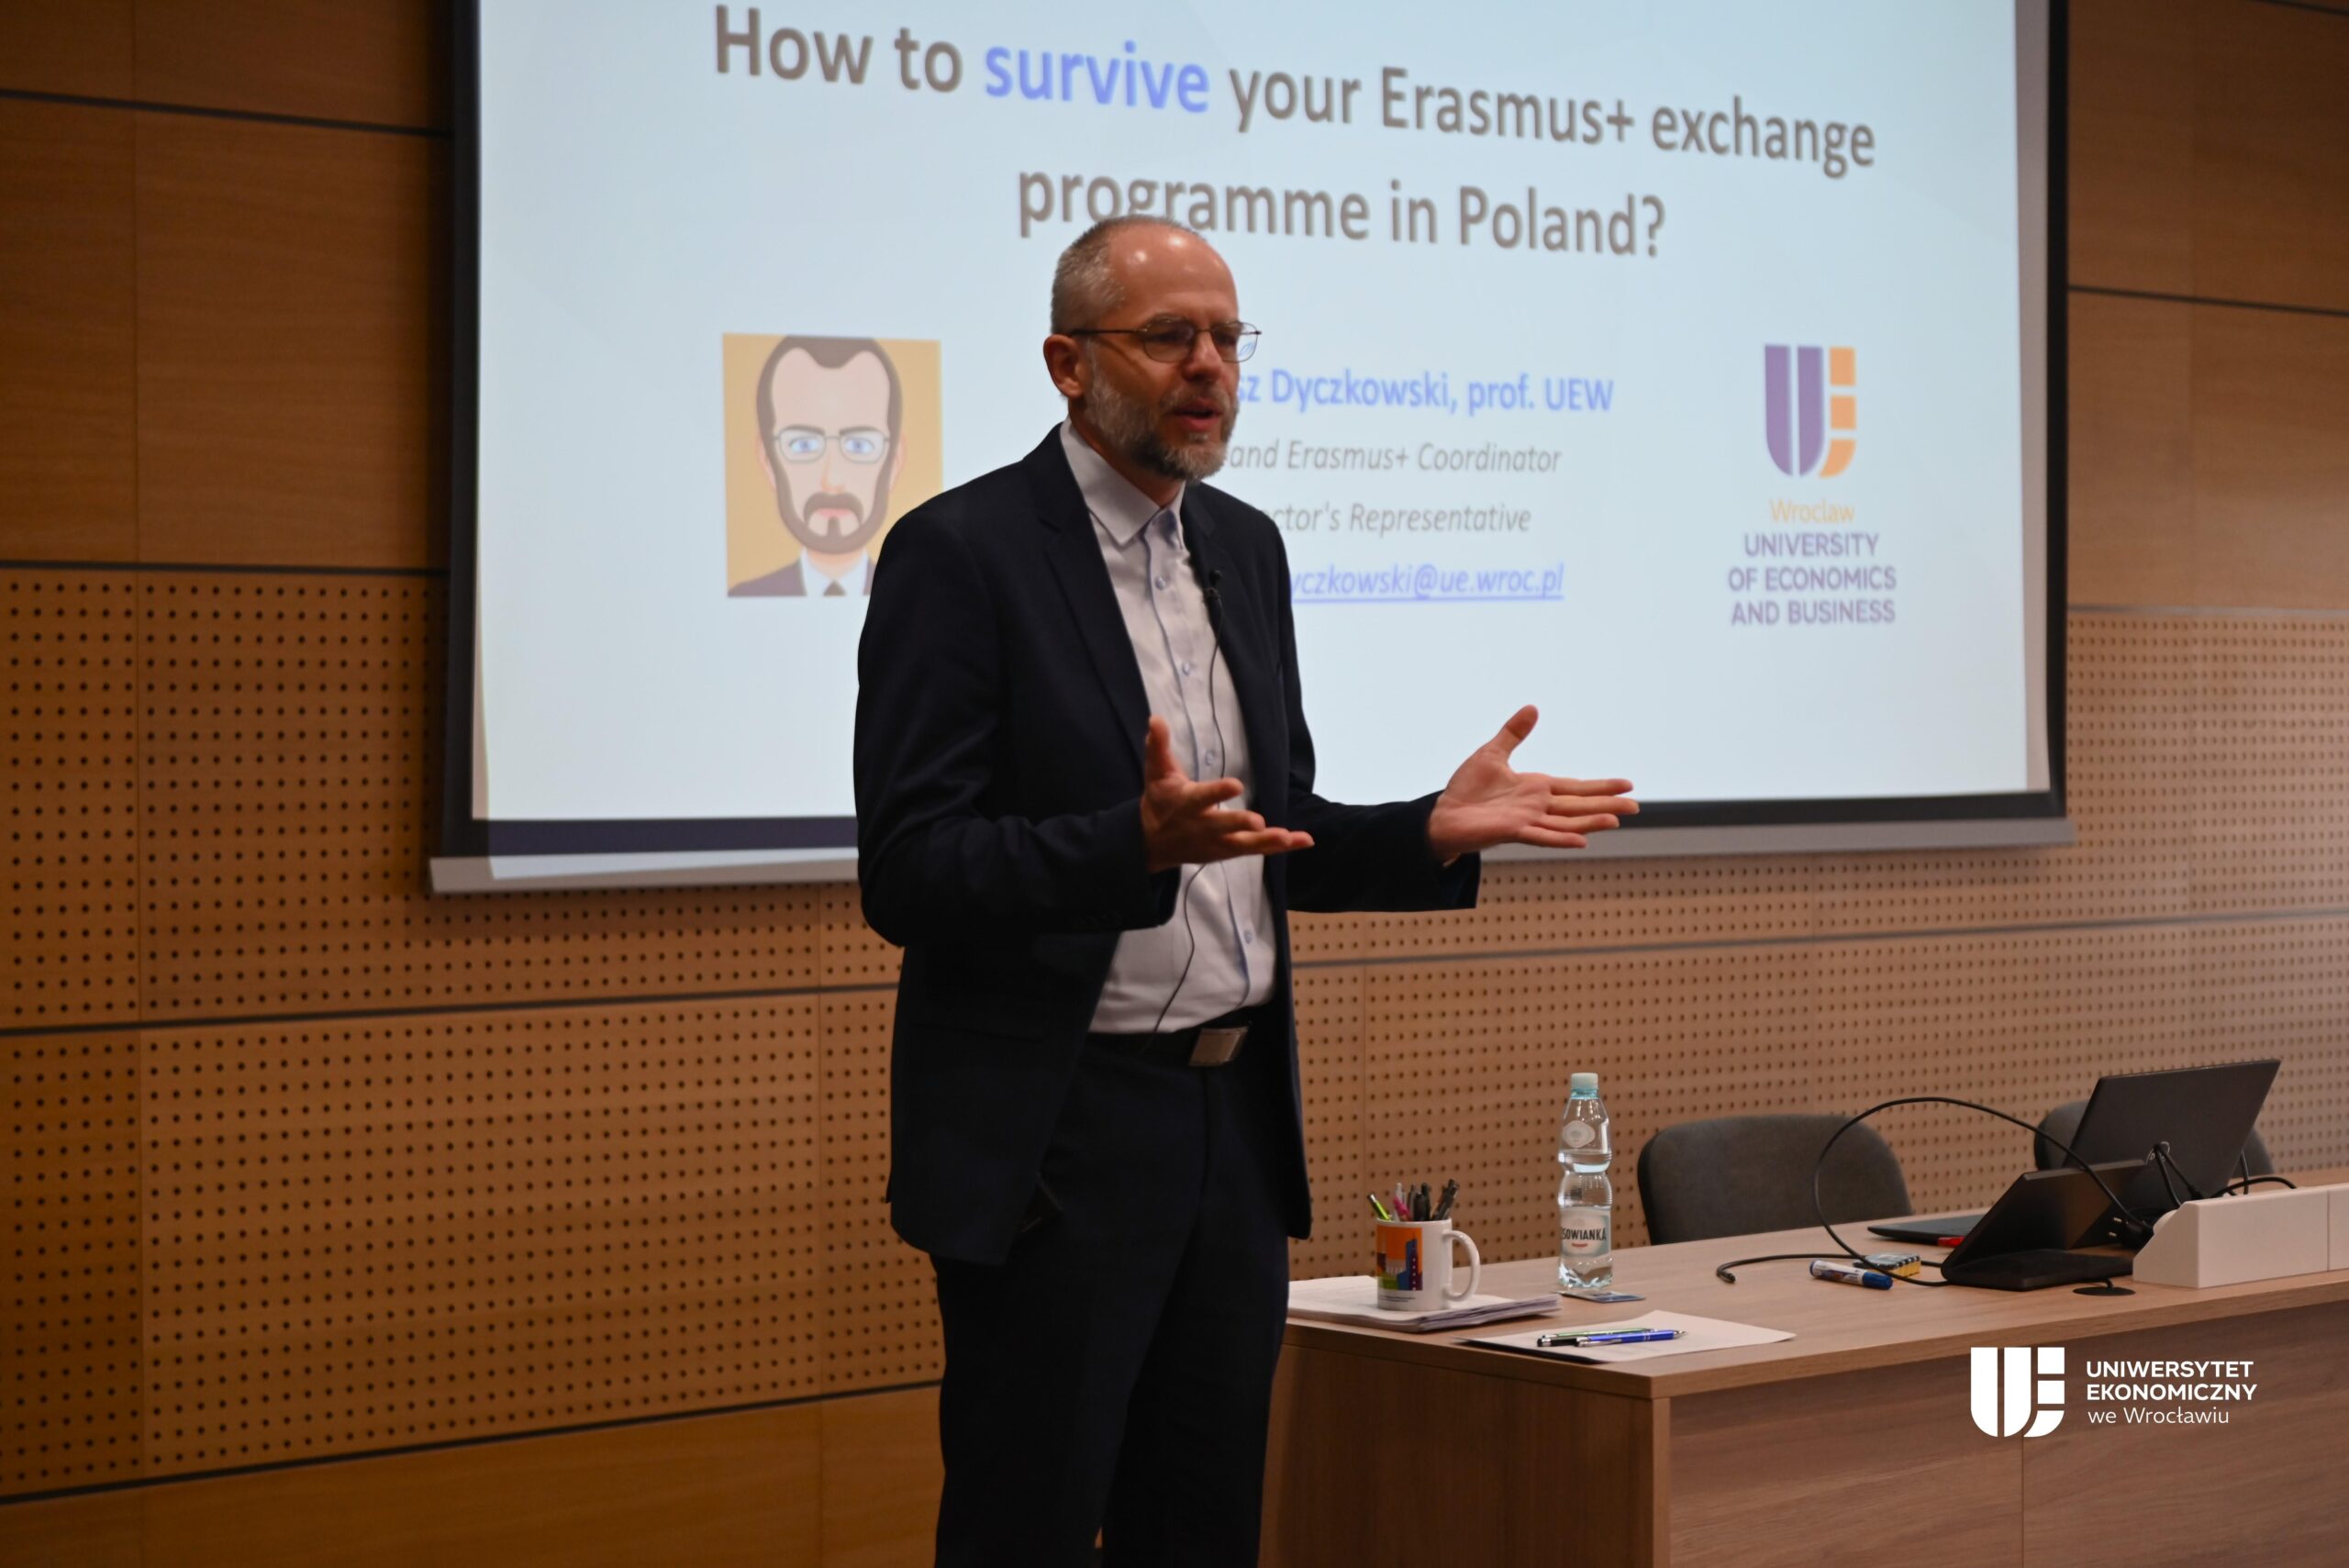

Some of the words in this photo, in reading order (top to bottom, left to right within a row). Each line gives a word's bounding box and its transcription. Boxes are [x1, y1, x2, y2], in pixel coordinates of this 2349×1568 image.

[716, 5, 874, 84] How
[894, 28, 963, 93] to
[985, 40, 1209, 113] survive
[1230, 68, 1361, 133] your
[1382, 66, 1634, 144] Erasmus+
[1653, 96, 1875, 179] exchange
[1019, 172, 1370, 240] programme
[1391, 180, 1437, 244] in
[1459, 184, 1665, 258] Poland?
[1272, 369, 1459, 415] Dyczkowski,
[1469, 373, 1534, 417] prof.
[1545, 377, 1615, 412] UEW
[1230, 439, 1279, 469] and
[1287, 440, 1409, 470] Erasmus+
[1418, 442, 1563, 473] Coordinator
[1265, 501, 1341, 531] ctor's
[1350, 503, 1531, 538] Representative
[1769, 499, 1855, 524] Wroclaw
[1743, 532, 1879, 557] UNIVERSITY
[1728, 567, 1757, 592] OF
[1765, 565, 1897, 592] ECONOMICS
[1731, 601, 1780, 626] AND
[1787, 599, 1896, 624] BUSINESS
